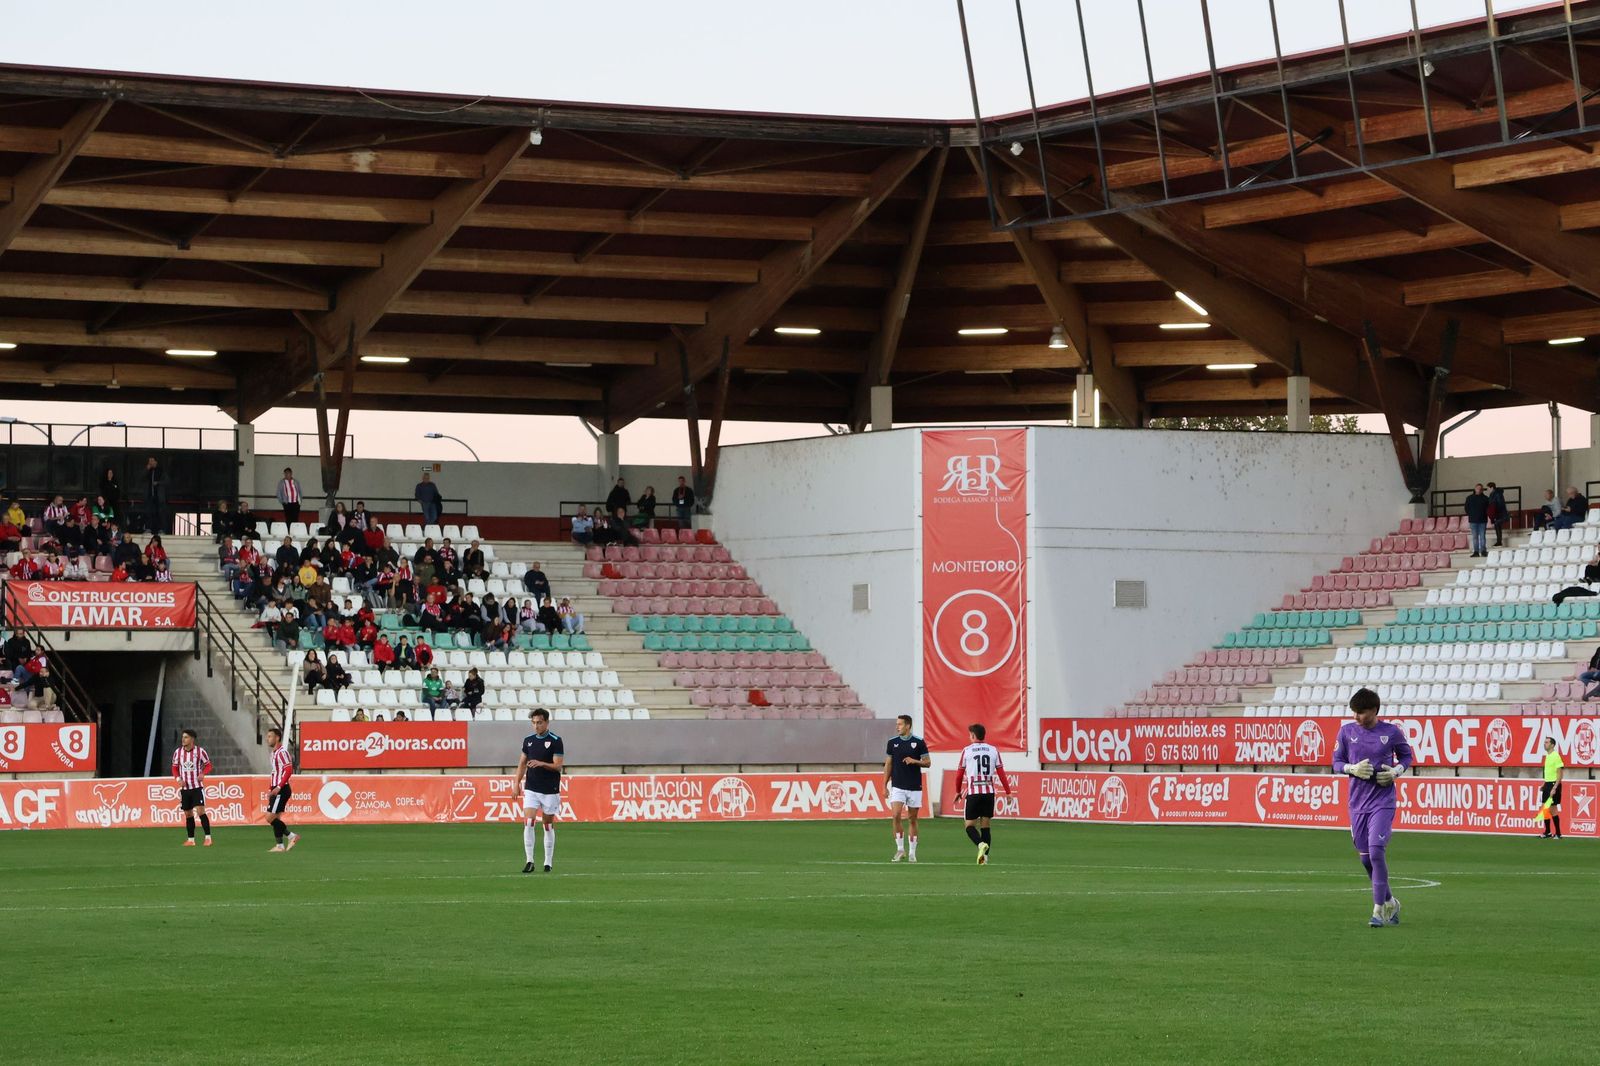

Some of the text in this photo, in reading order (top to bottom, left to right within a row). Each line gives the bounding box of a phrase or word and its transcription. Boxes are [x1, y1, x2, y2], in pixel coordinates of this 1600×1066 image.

[933, 496, 961, 504] BODEGA
[990, 495, 1014, 503] RAMOS
[932, 559, 1017, 573] MONTETORO
[154, 616, 175, 626] S.A.
[959, 609, 990, 657] 8
[1134, 720, 1227, 738] www.cubiex.es
[1234, 720, 1291, 740] FUNDACIÓN
[3, 730, 19, 754] 8
[69, 729, 84, 753] 8
[1042, 720, 1132, 762] cubiex
[51, 741, 74, 769] ZAMORA
[1161, 744, 1219, 760] 675 630 110
[973, 754, 991, 776] 19
[291, 791, 312, 800] todos
[355, 791, 377, 800] COPE
[610, 777, 703, 799] FUNDACIÓN
[1041, 775, 1097, 796] FUNDACIÓN
[1163, 776, 1230, 807] Freigel
[1270, 777, 1340, 811] Freigel
[13, 788, 60, 824] CF
[355, 800, 392, 809] ZAMORA
[395, 797, 424, 806] COPE.es
[1416, 783, 1473, 809] CAMINO
[1477, 784, 1494, 810] DE
[1498, 785, 1516, 811] LA
[1400, 810, 1444, 826] Morales
[1446, 811, 1463, 826] del
[1467, 811, 1491, 827] Vino
